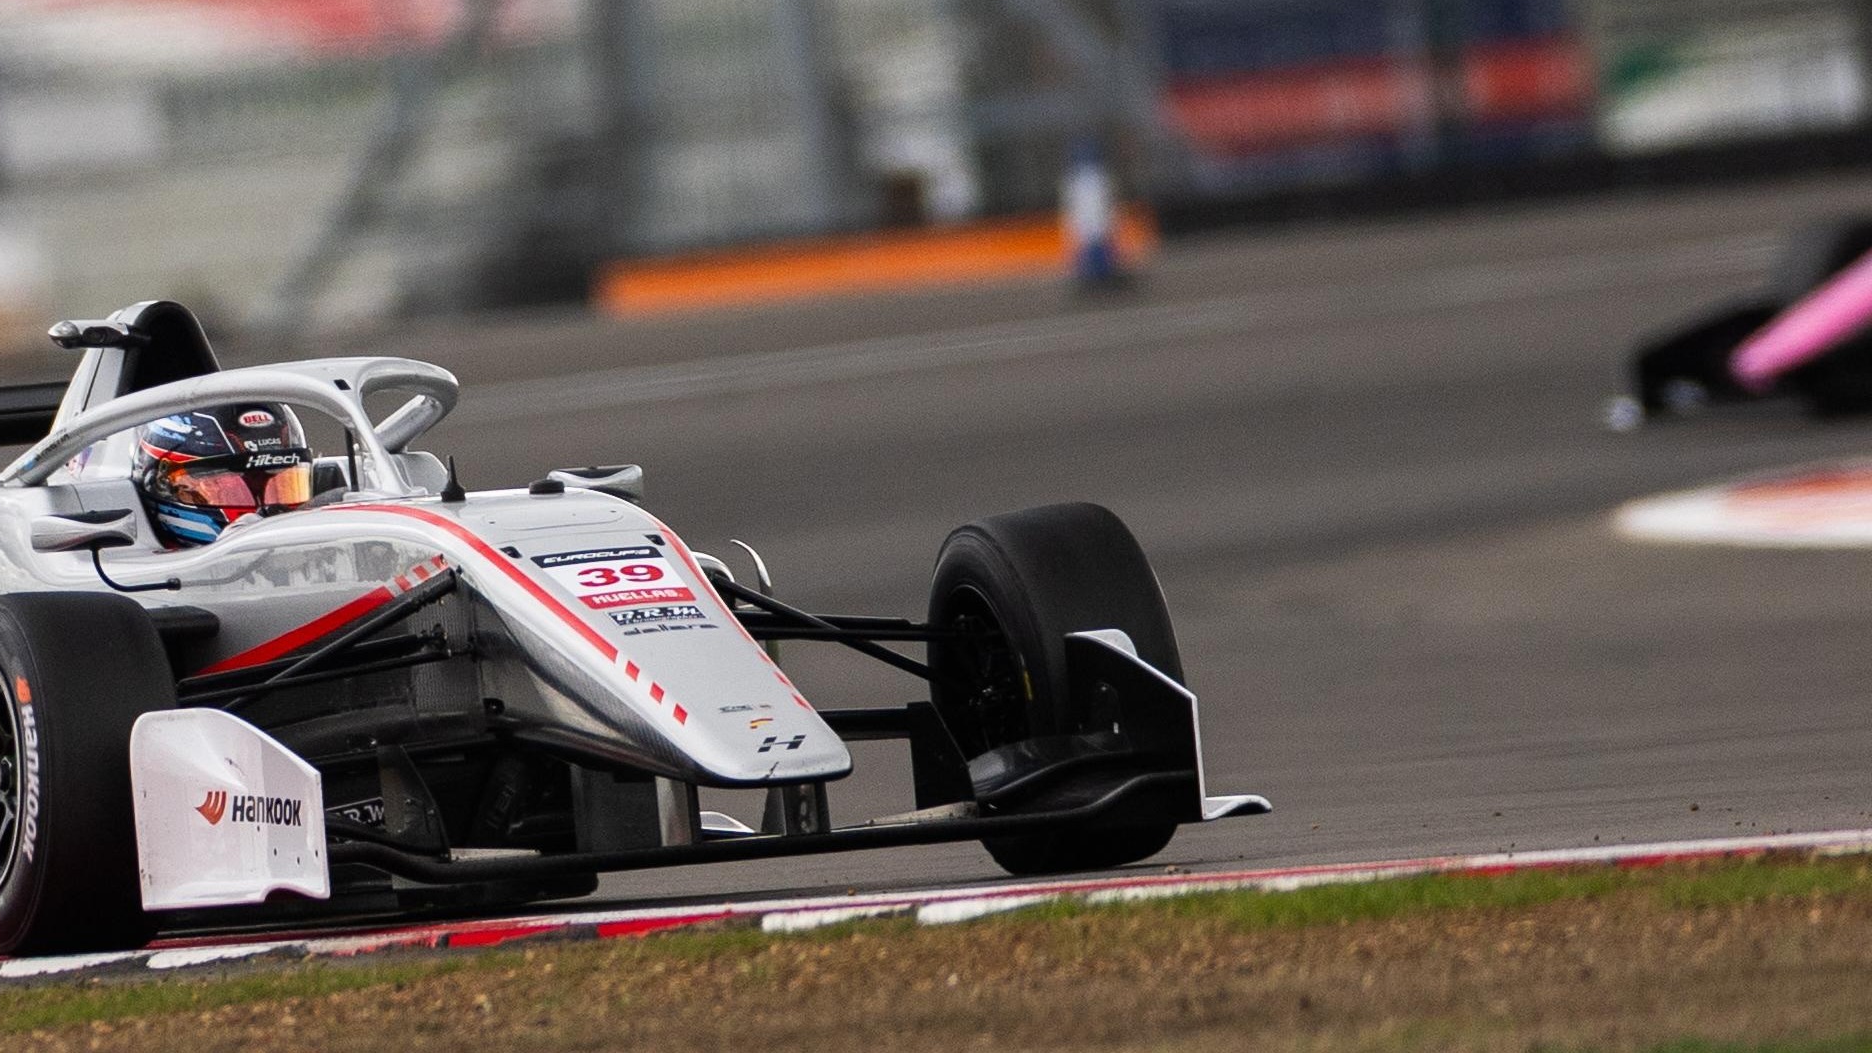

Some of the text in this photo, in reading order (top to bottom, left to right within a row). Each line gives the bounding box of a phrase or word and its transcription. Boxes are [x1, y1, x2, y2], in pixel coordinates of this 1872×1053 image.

[243, 414, 271, 424] BELL
[246, 453, 300, 468] Hitech
[577, 564, 664, 587] 39
[623, 622, 719, 636] dallara
